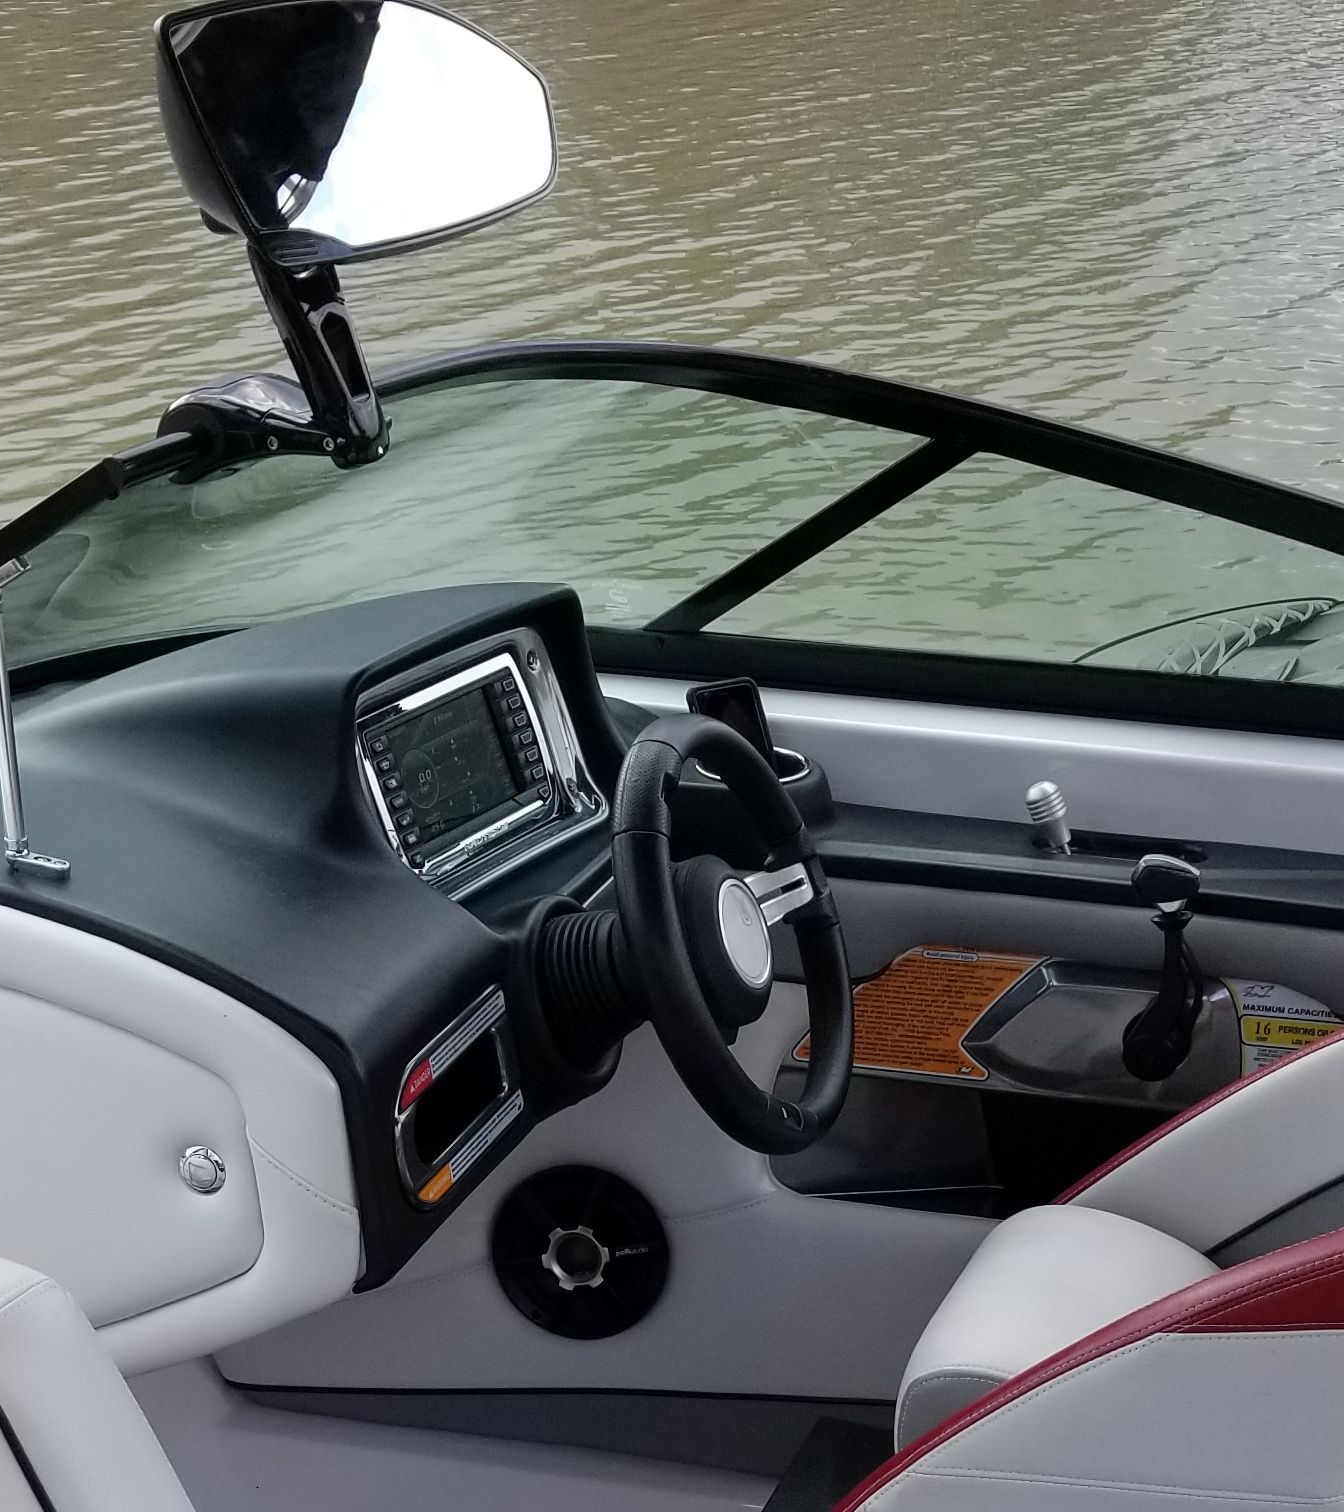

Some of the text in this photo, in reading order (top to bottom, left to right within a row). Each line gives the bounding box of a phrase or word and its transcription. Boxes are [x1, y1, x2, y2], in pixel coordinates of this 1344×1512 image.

[1242, 1003, 1334, 1018] MAXIMUM CAPACITIE
[1255, 1021, 1271, 1036] 16
[1278, 1025, 1316, 1037] PERSONS
